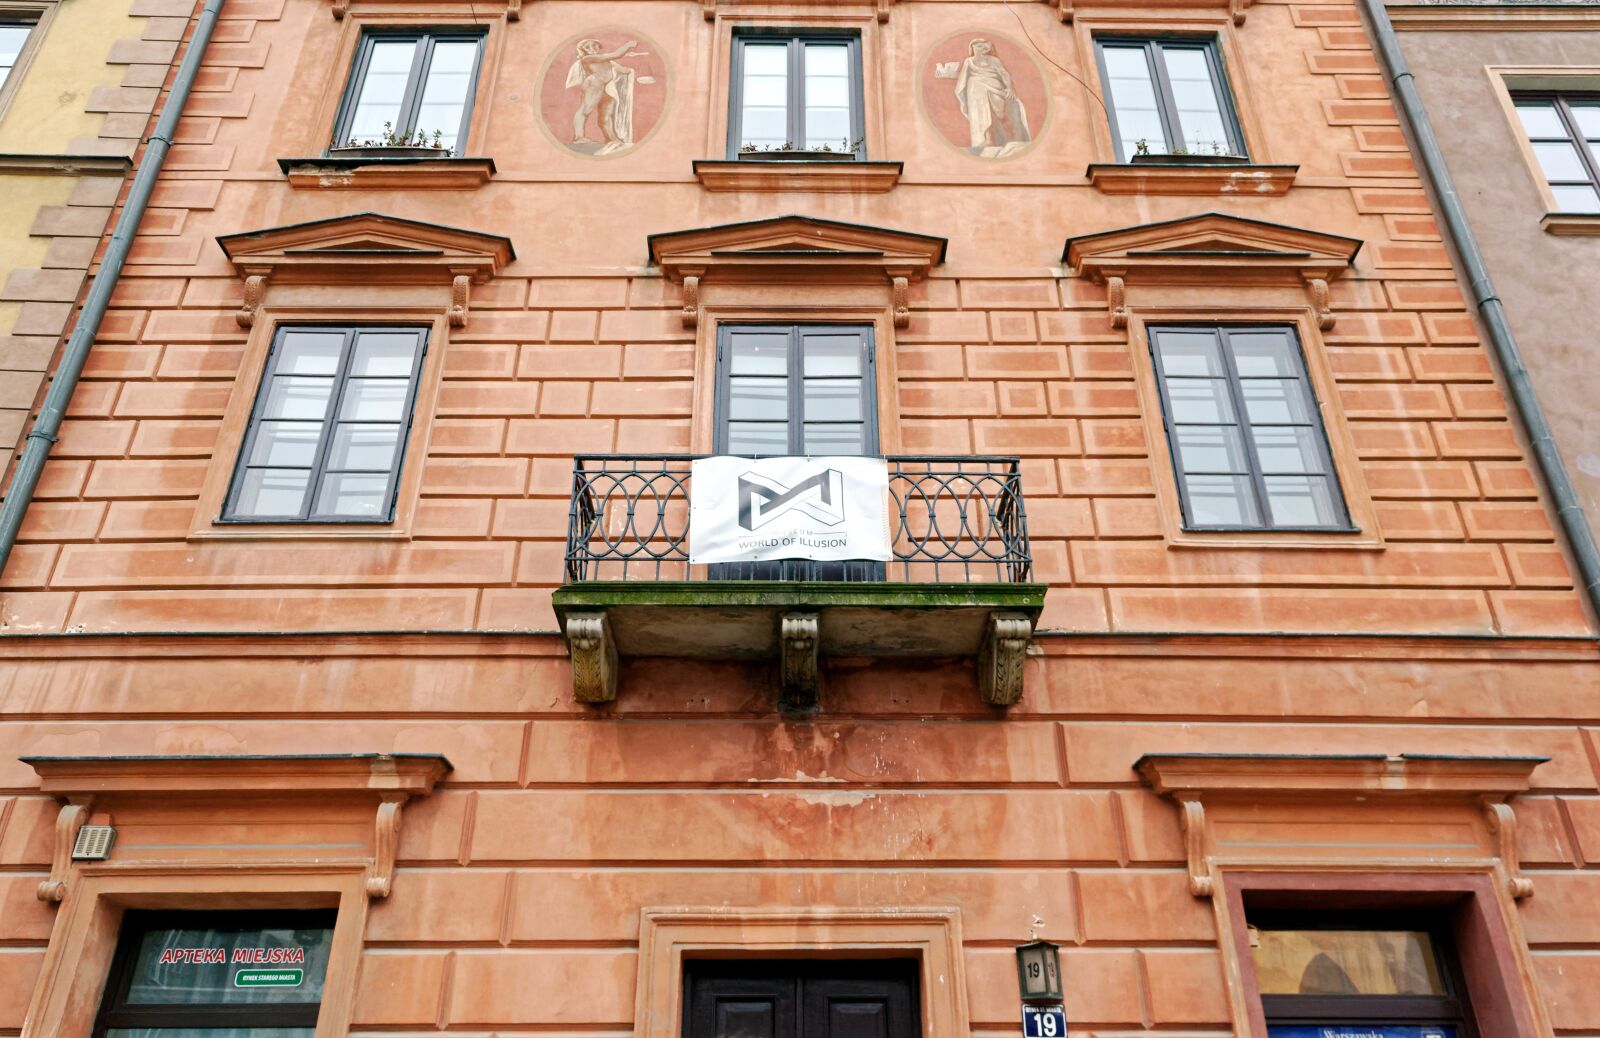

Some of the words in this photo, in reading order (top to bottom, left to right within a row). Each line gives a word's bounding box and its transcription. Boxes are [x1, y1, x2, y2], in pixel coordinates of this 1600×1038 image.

[738, 538, 779, 549] WORLD
[782, 537, 797, 547] OF
[799, 537, 847, 548] ILLUSION
[160, 948, 226, 964] APTEKA
[231, 948, 305, 963] MIEJSKA
[1027, 962, 1040, 978] 19
[1033, 1013, 1057, 1037] 19
[1323, 1028, 1384, 1038] Warszawska
